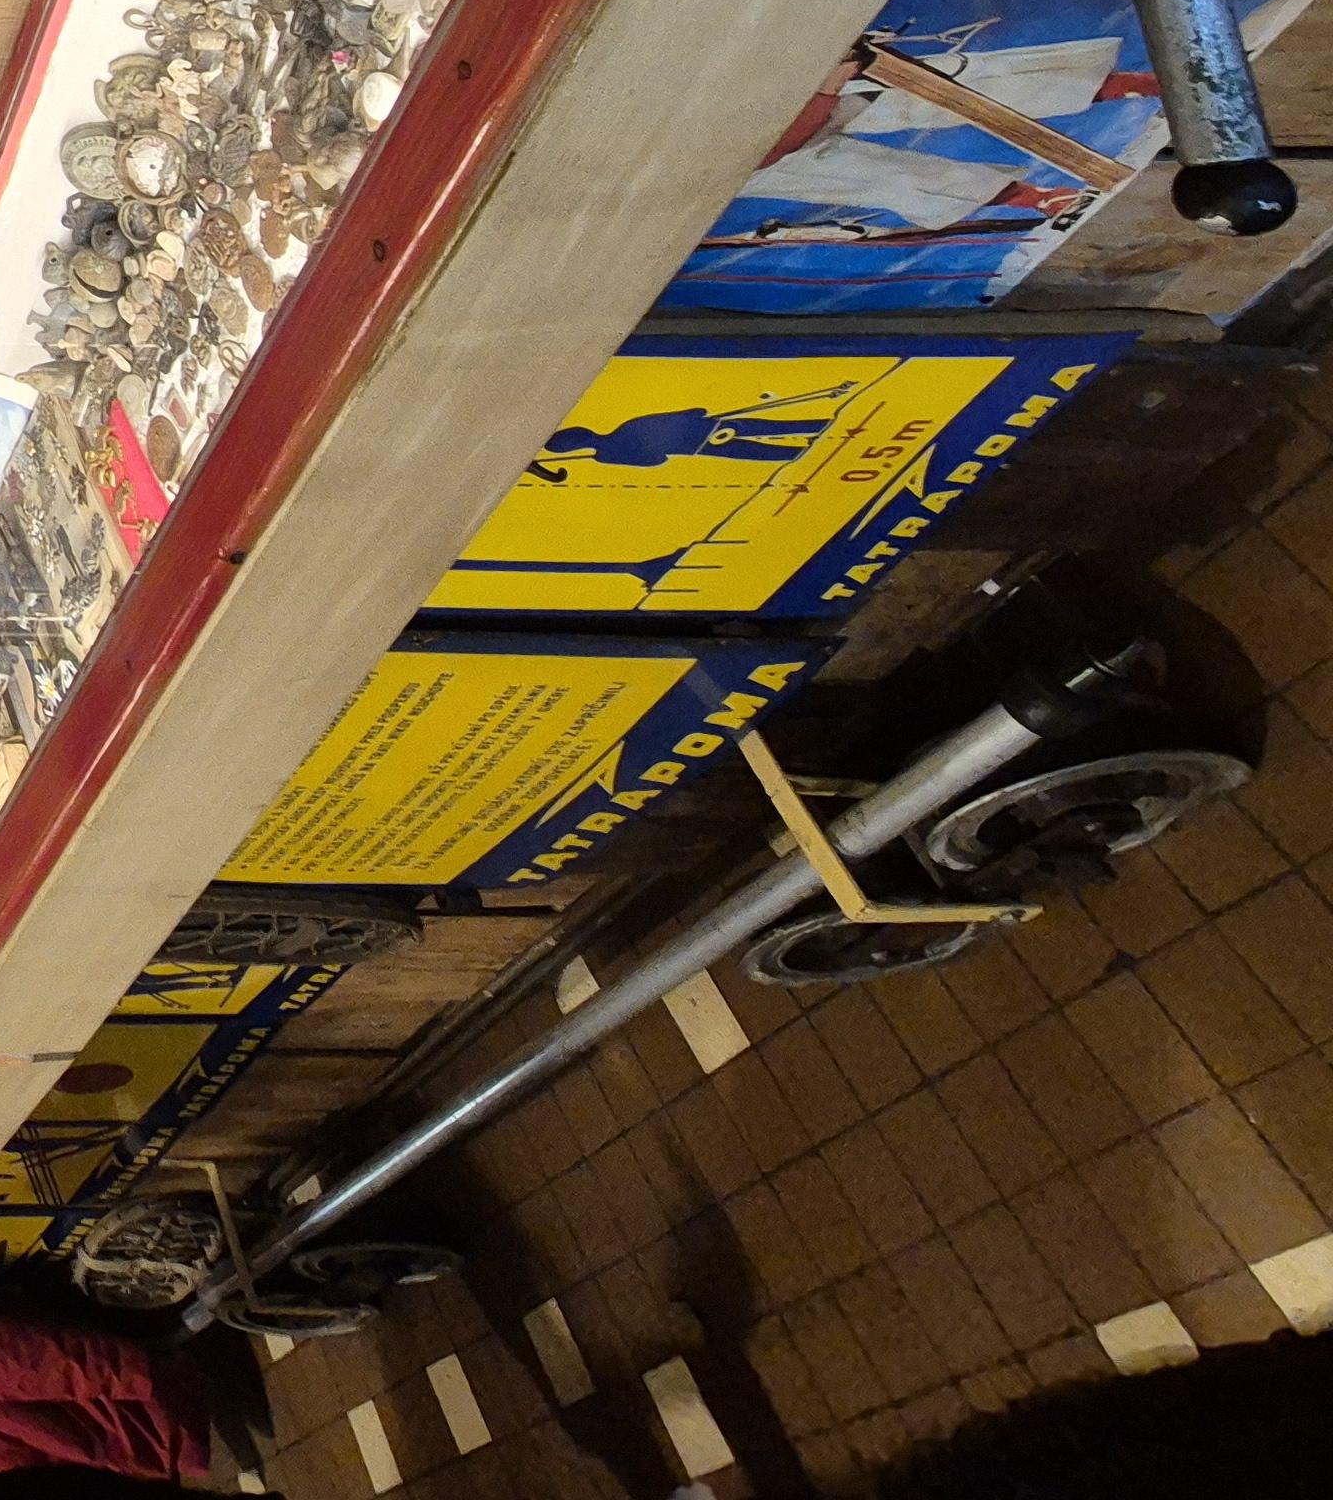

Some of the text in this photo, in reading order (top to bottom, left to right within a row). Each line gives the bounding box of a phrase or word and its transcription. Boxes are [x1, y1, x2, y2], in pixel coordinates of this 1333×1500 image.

[819, 361, 1099, 602] TATRAPOMA
[505, 658, 809, 884] TATRAPOMA
[177, 1025, 272, 1119] TATRAPOMA
